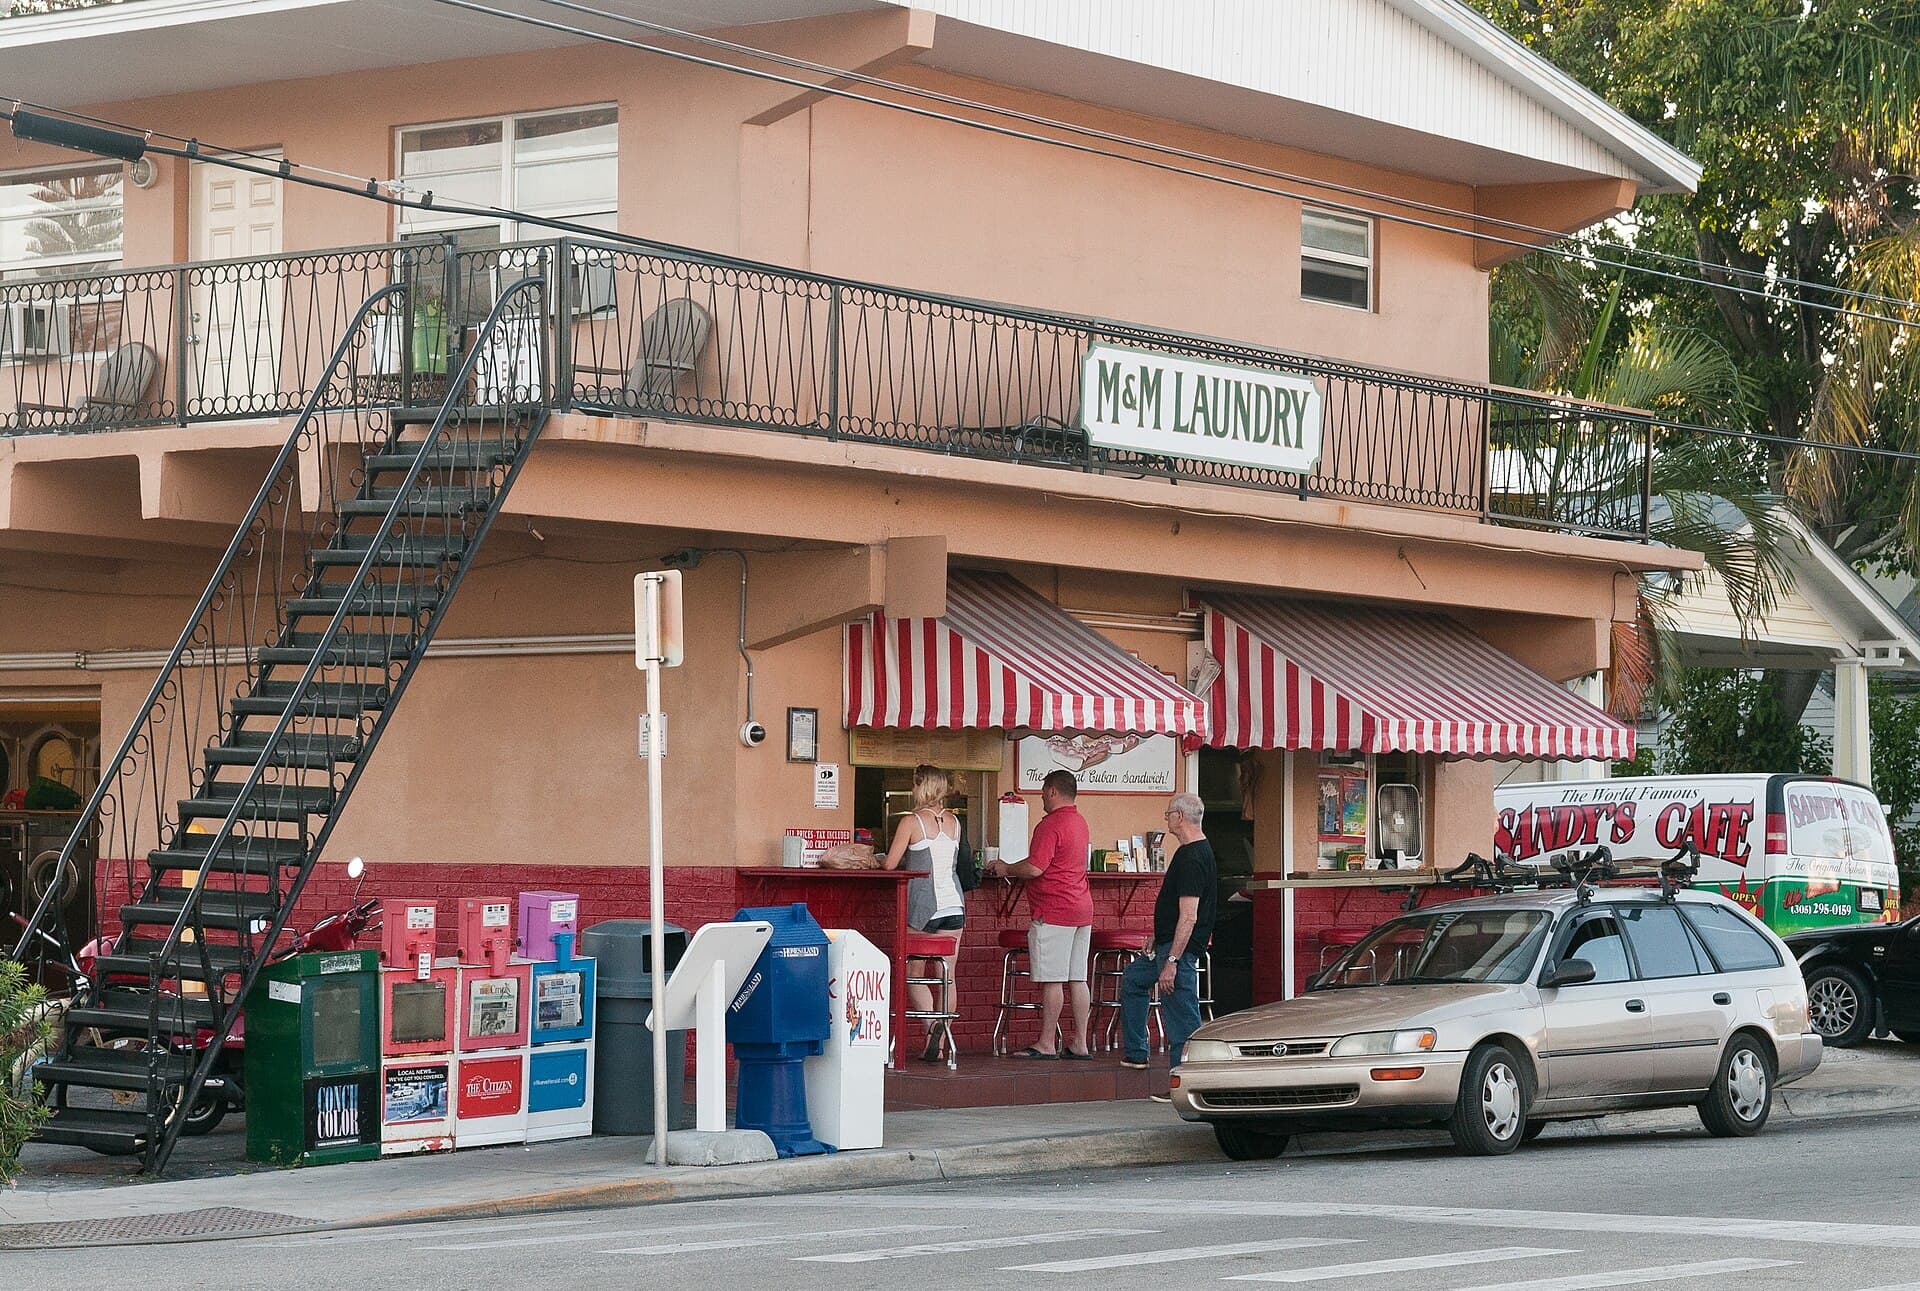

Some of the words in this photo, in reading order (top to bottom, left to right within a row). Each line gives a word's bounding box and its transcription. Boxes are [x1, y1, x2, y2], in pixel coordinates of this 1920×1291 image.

[1096, 359, 1164, 430] M&M
[1172, 370, 1311, 450] LAUNDRY
[1026, 768, 1044, 782] The
[1088, 769, 1118, 783] Cuban
[1121, 770, 1170, 784] Sandwich!
[1561, 789, 1588, 802] The
[1592, 787, 1637, 801] World
[1638, 786, 1700, 800] Famous
[816, 830, 826, 840] TAX
[827, 830, 850, 840] INCLUDED
[1494, 801, 1637, 862] SANDY'S
[1655, 798, 1754, 868] CAFE
[814, 840, 833, 849] CREDIT
[1785, 857, 1806, 872] The
[1731, 892, 1758, 903] OPEN
[1790, 904, 1811, 915] (305)
[846, 970, 885, 1001] KONK
[858, 1009, 882, 1040] Life
[466, 1083, 481, 1094] THE
[482, 1078, 513, 1093] CITIZEN
[317, 1084, 359, 1112] CONCH
[317, 1108, 361, 1139] COLOR
